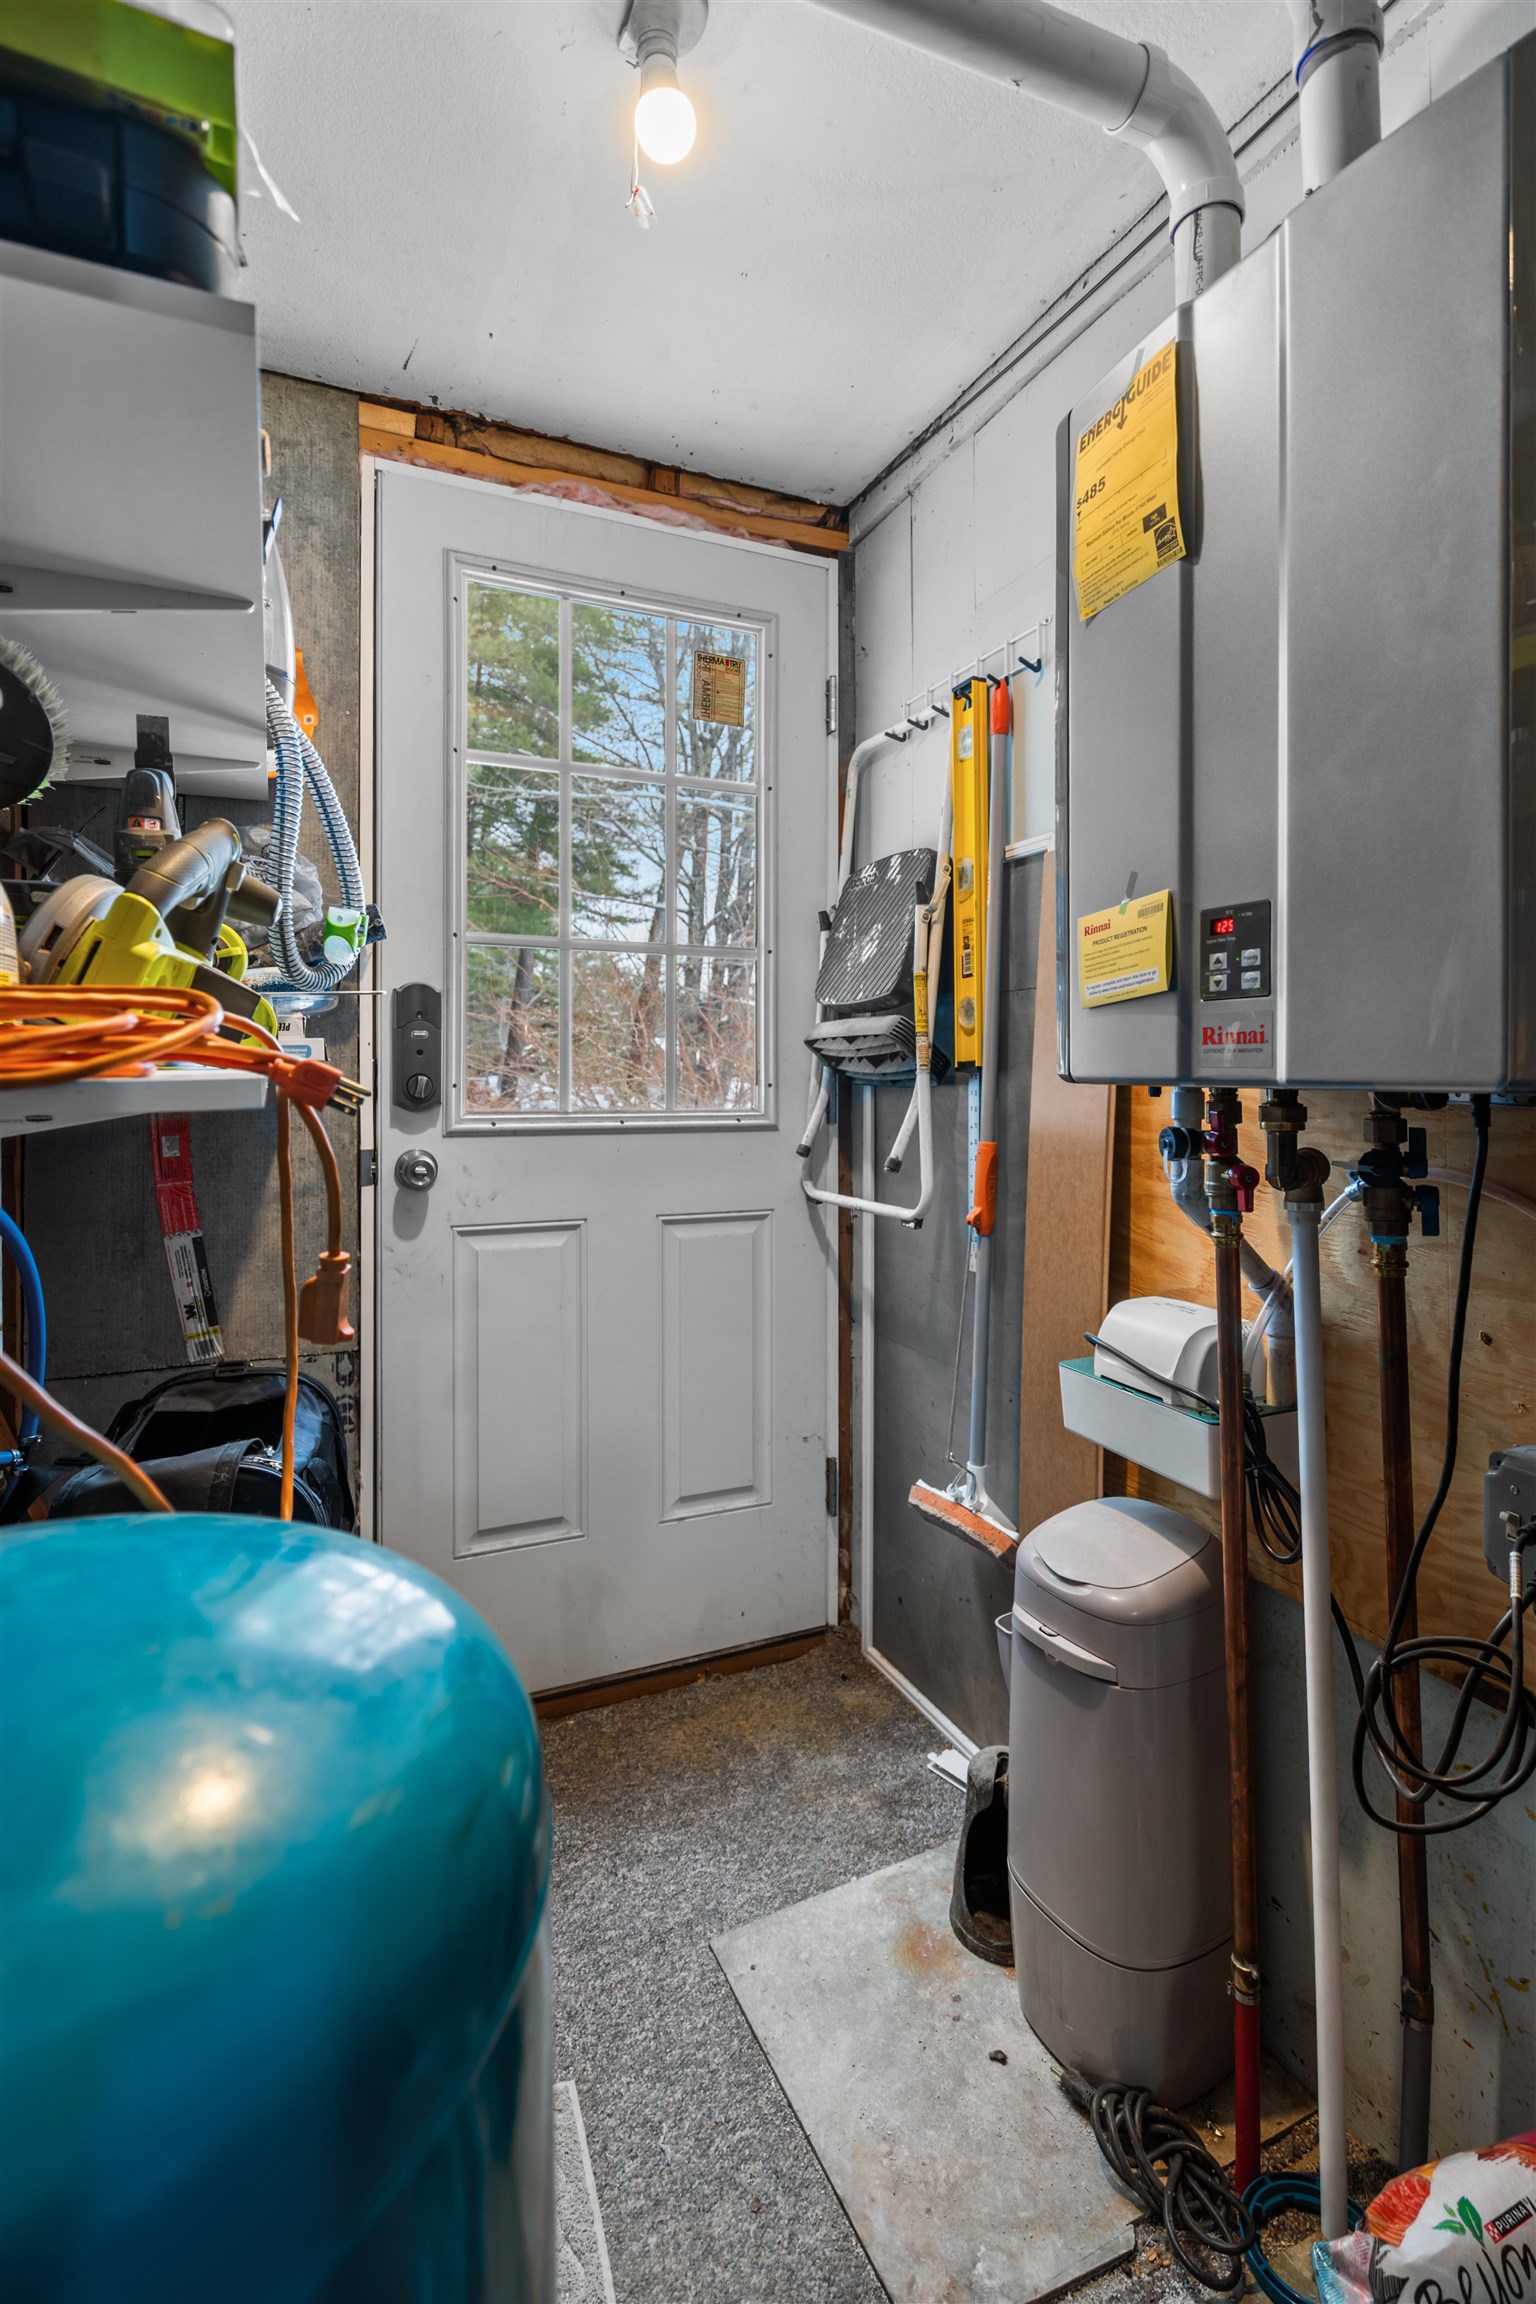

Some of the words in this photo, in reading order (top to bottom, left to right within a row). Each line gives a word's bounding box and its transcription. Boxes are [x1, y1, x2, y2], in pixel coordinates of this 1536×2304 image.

[1084, 918, 1111, 936] Rinnai
[1092, 936, 1113, 946] PRODUCT
[1114, 926, 1148, 940] REGISTRATION
[1216, 919, 1233, 933] 125
[1202, 1024, 1265, 1046] Rinnai
[1496, 2204, 1528, 2234] PURINA
